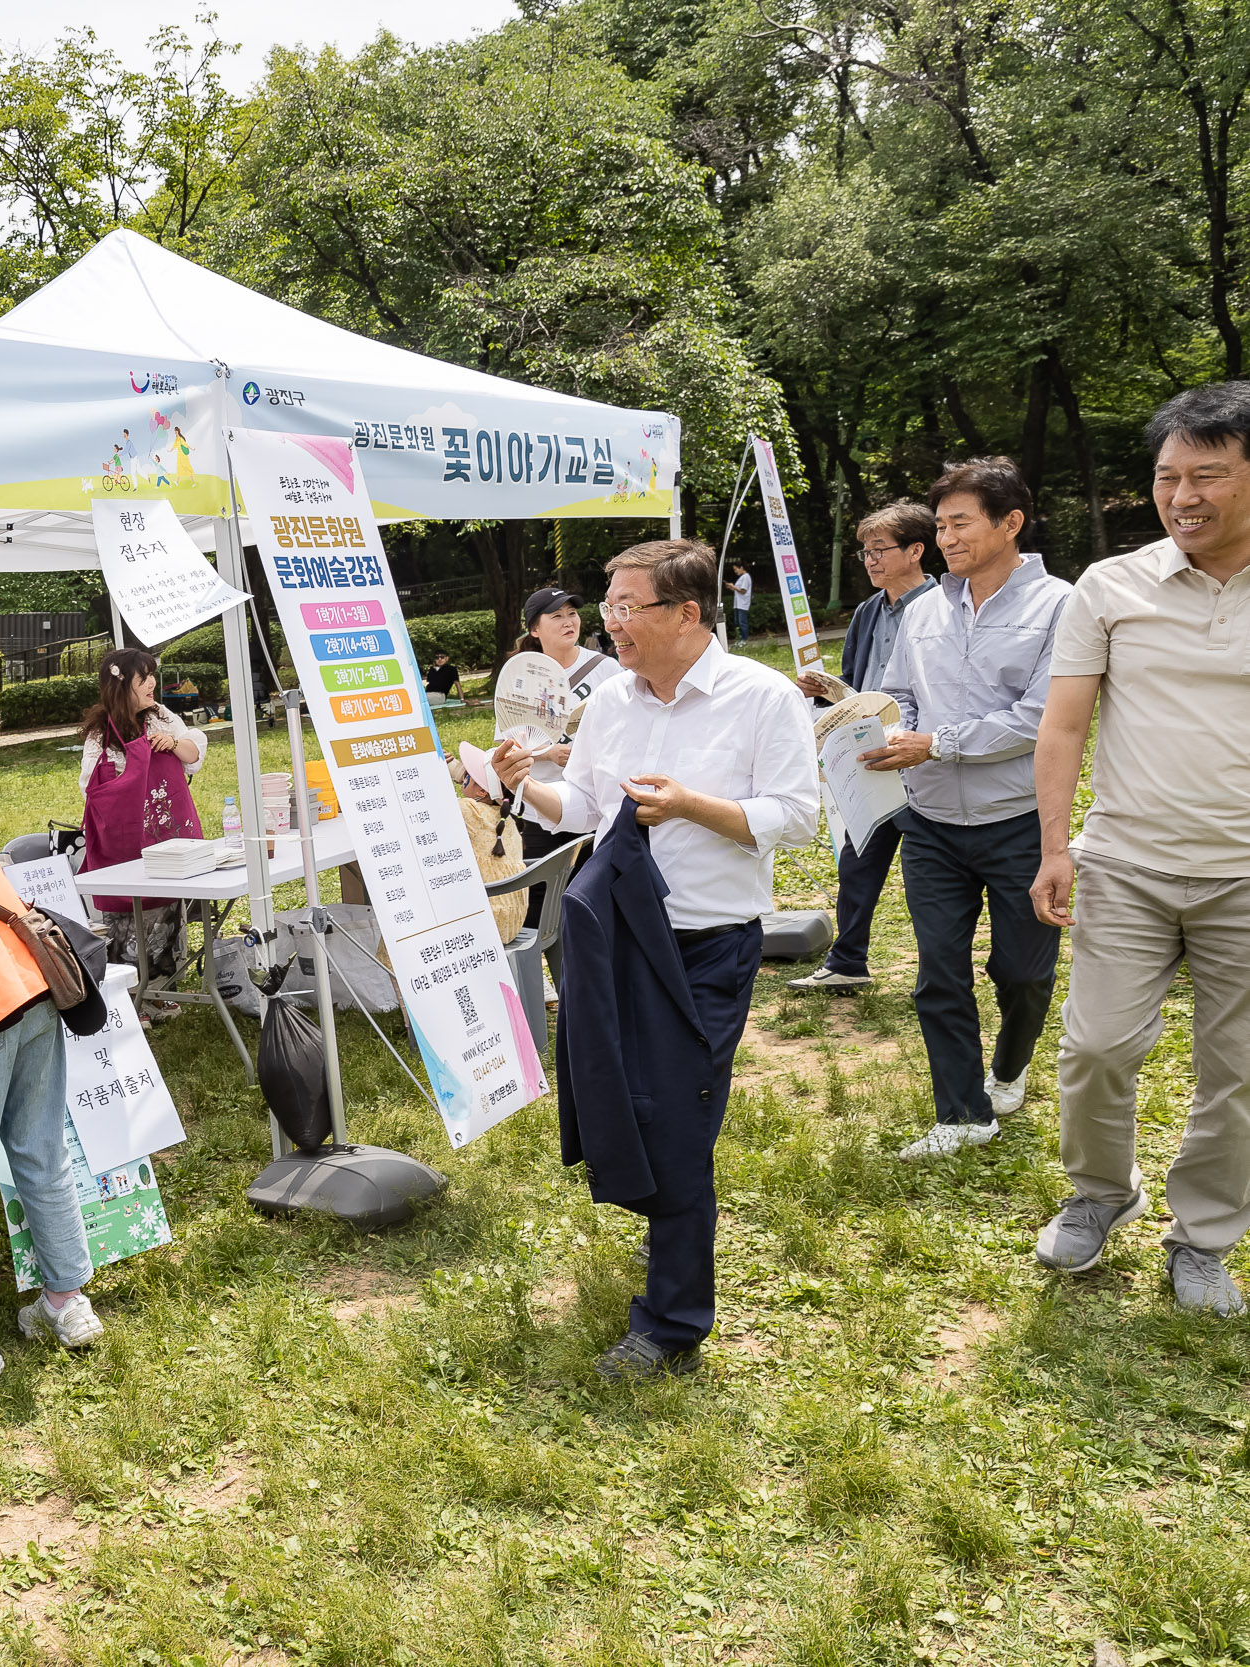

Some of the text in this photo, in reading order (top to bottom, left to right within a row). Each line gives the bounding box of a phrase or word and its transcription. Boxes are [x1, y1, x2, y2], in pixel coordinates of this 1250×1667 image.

[265, 388, 306, 406] 광진구
[353, 421, 615, 486] 광진문화원 꽃이야기교실
[279, 476, 301, 489] 문화로
[284, 491, 332, 503] 예술로 행복하게
[119, 511, 146, 532] 현장
[270, 516, 366, 549] 광진문화원
[120, 540, 168, 563] 접수자
[273, 555, 385, 589] 문화예술강좌
[315, 605, 370, 625] 1학기(1~3월)
[324, 635, 379, 655] 2학기(4~6월)
[334, 665, 388, 686] 3학기(7~9월)
[340, 694, 403, 717] 4학기(10~12월)
[350, 734, 416, 760] 문화예술강좌 분야
[362, 820, 385, 836] 음악강좌
[419, 942, 442, 964] 방문접수
[444, 931, 475, 955] 온라인접수
[93, 1047, 113, 1070] 및
[462, 1031, 502, 1063] www.kjcc.or.kr
[473, 1054, 506, 1082] 02)447-0244
[75, 1068, 155, 1110] 작품제출처
[489, 1078, 518, 1106] 광진문화원
